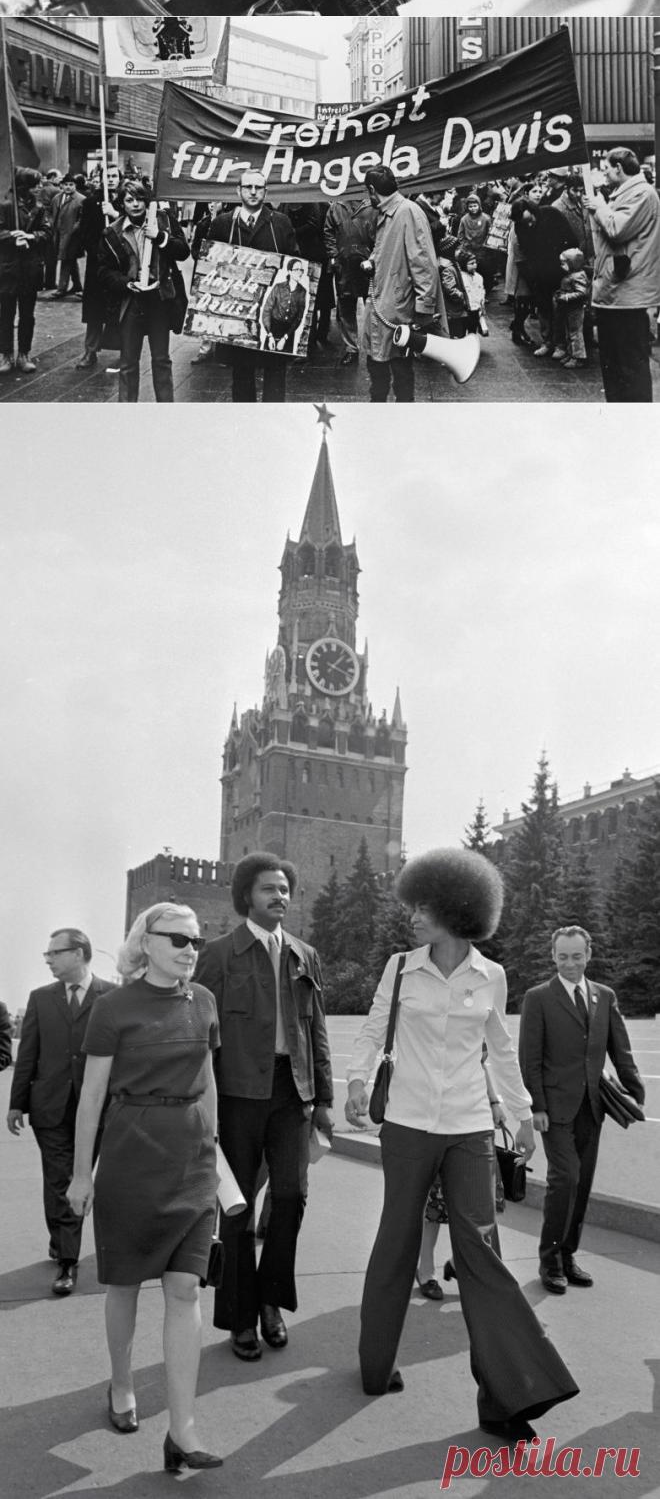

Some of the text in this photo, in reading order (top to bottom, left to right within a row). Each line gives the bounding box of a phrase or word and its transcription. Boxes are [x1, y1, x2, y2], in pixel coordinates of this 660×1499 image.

[172, 111, 573, 197] für Angela Davis
[232, 86, 430, 148] Freiheit
